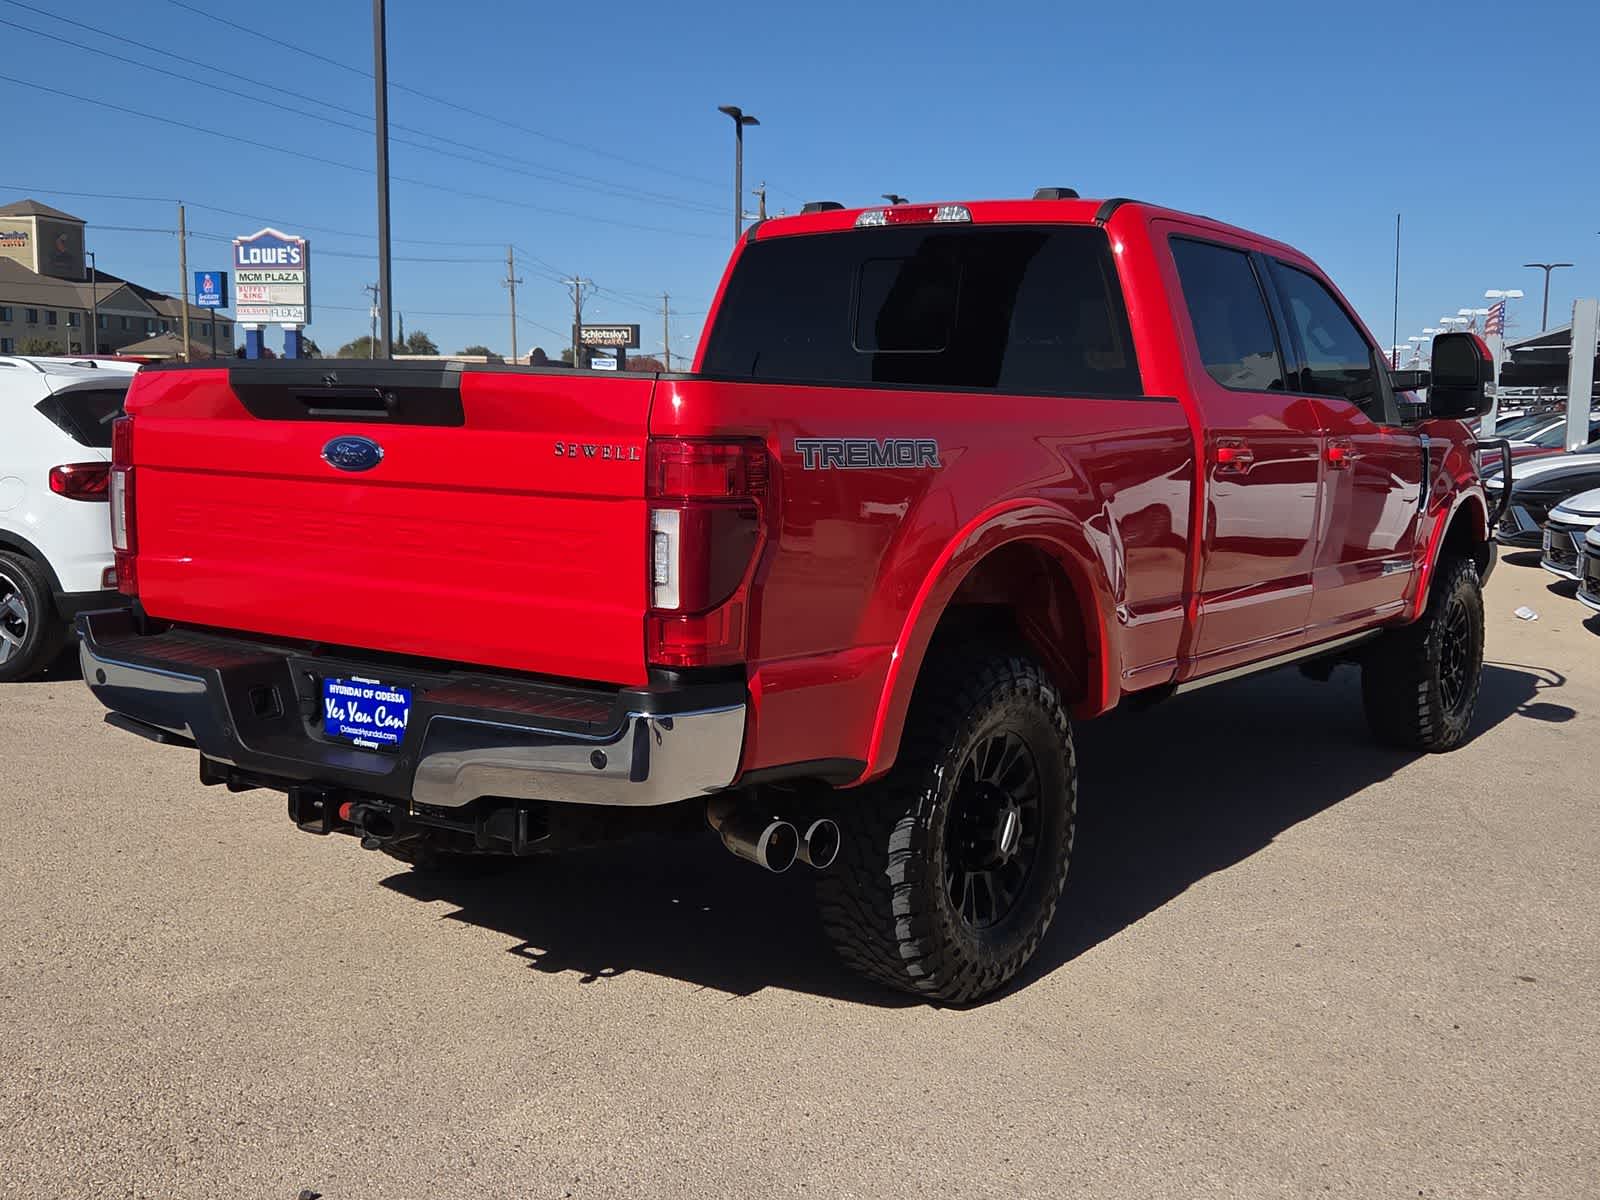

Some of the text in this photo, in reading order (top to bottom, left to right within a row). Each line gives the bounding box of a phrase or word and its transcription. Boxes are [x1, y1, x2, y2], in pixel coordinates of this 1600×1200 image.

[239, 246, 300, 264] LOWE'S
[239, 273, 299, 281] MCM PLAZA
[553, 441, 641, 461] SEWELL
[794, 438, 942, 470] TREMOR
[329, 684, 405, 704] HYUNDAI OF ODESSA
[325, 698, 409, 729] Yes You Can!
